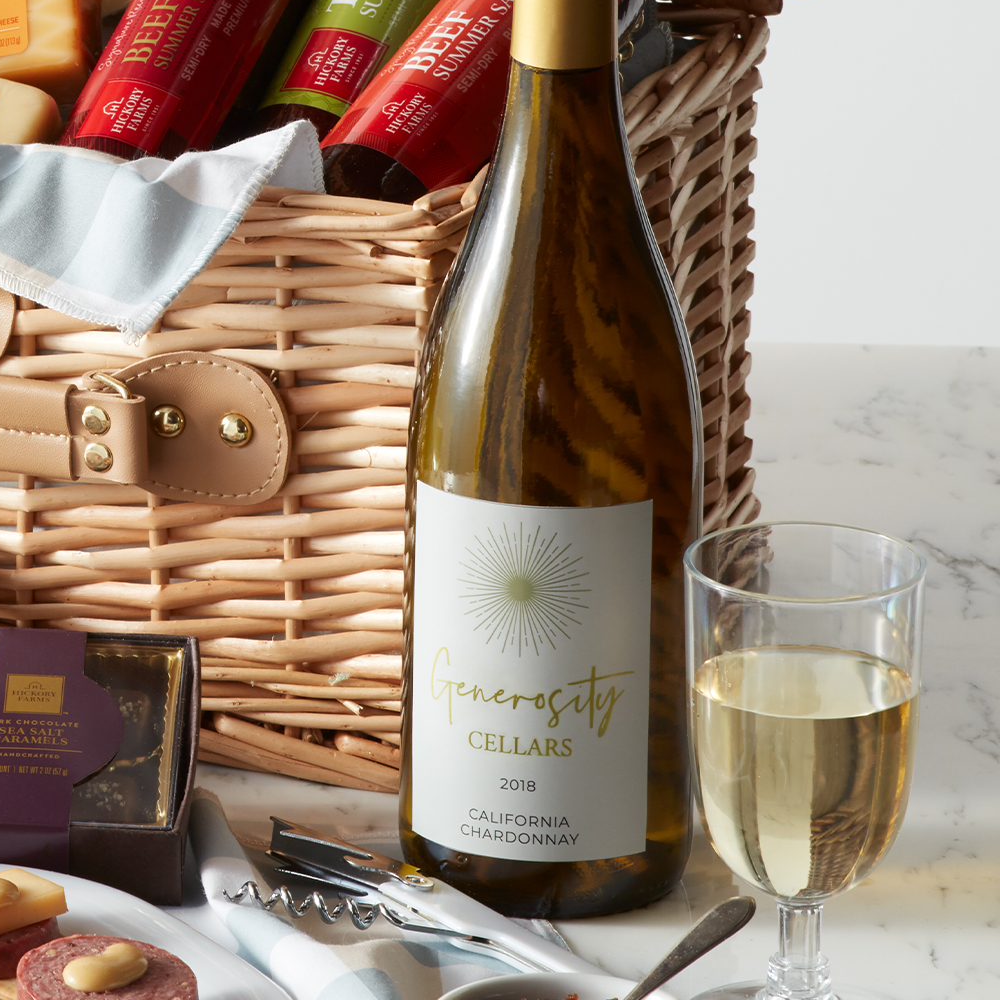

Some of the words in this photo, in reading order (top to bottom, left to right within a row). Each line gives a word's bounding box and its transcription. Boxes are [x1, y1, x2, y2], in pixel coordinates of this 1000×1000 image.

[153, 2, 201, 70] SUMMER
[181, 34, 212, 81] SEMI-DRY
[210, 0, 232, 28] MADE
[400, 10, 474, 74] BEEF
[432, 16, 500, 81] SUMMER
[314, 36, 349, 87] HICKORY
[330, 46, 358, 84] FARMS
[456, 48, 498, 94] SEMI-DRY
[111, 87, 144, 134] HICKORY
[126, 96, 154, 132] FARMS
[385, 92, 426, 134] HICKORY
[402, 102, 433, 134] FARMS
[12, 690, 57, 698] HICKORY
[430, 646, 635, 739] Generosity
[16, 719, 80, 728] CHOCOLATE
[30, 728, 64, 736] SALT
[468, 730, 573, 758] CELLARS
[499, 777, 537, 793] 2018
[460, 823, 580, 846] CHARDONNAY
[468, 808, 571, 829] CALIFORNIA
